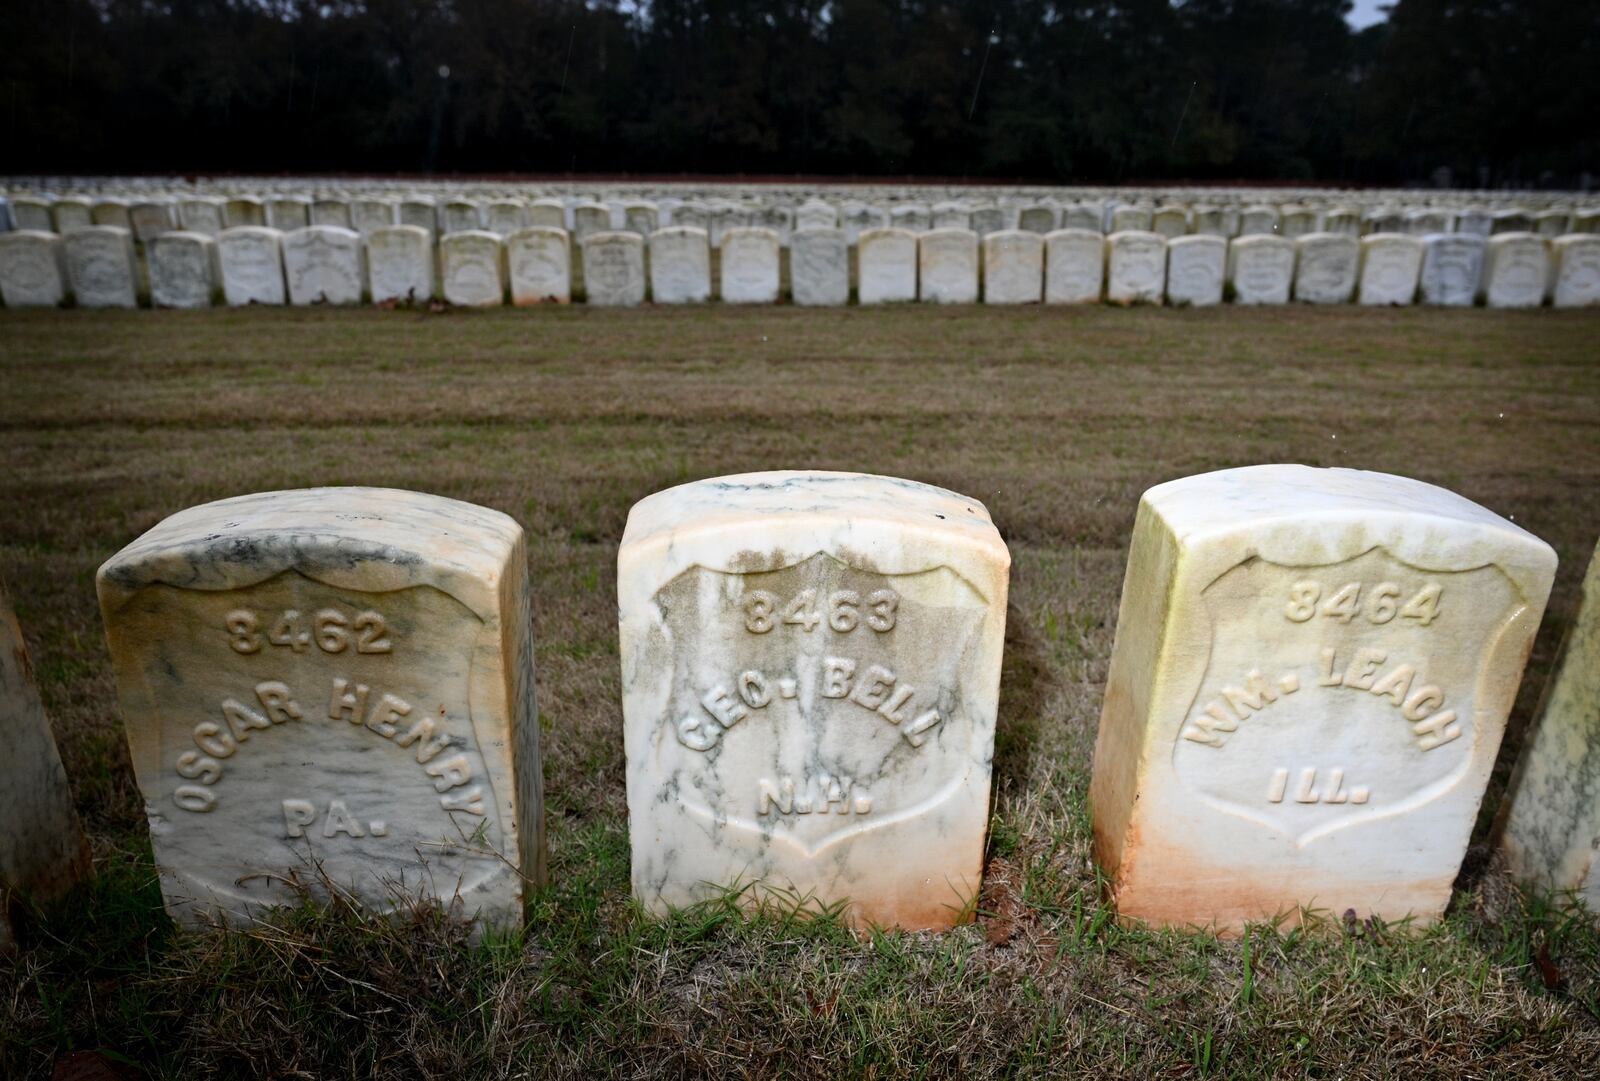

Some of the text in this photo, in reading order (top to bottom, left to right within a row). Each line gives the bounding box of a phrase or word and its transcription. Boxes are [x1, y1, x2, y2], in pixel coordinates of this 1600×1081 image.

[745, 589, 898, 633] 8463
[1284, 580, 1444, 625] 8464
[822, 656, 942, 748] BELL
[1184, 649, 1462, 751] WM. LEACH
[173, 677, 486, 816] OSCAR HENRY
[757, 773, 872, 815] N.H.
[1268, 768, 1370, 804] ILL.
[281, 799, 388, 839] PA.
